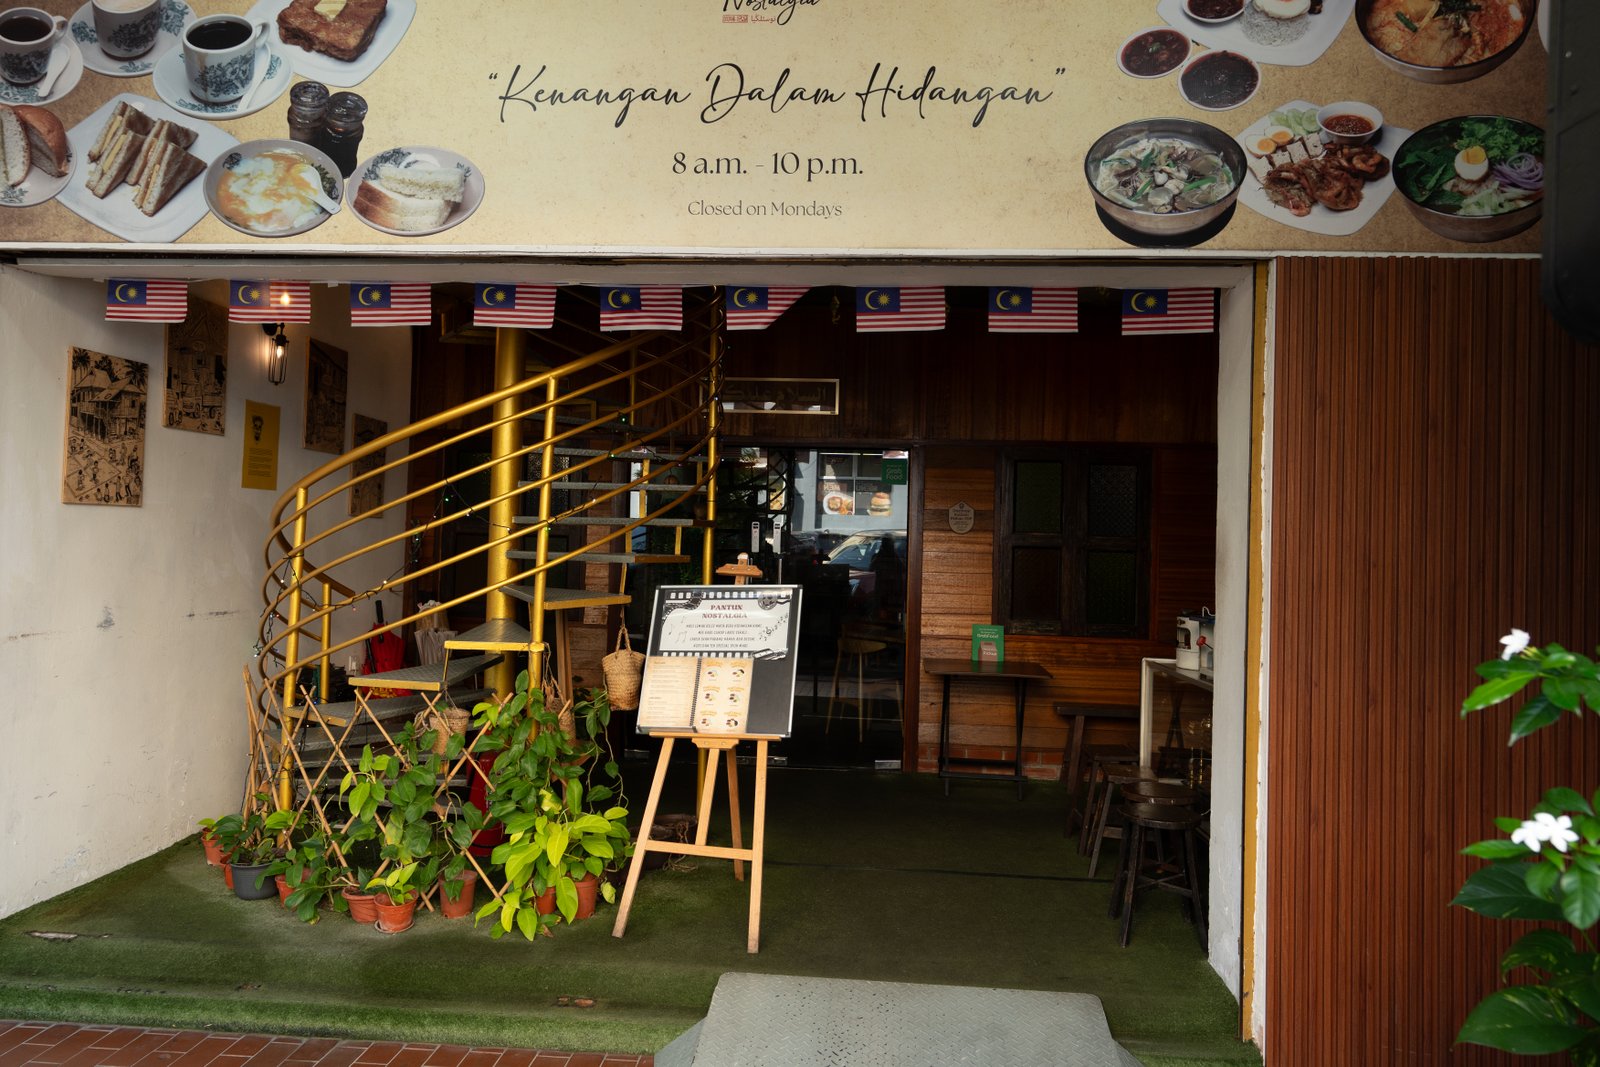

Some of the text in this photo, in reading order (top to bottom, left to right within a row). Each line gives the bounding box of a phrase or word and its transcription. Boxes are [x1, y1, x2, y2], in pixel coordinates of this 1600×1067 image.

[700, 62, 846, 124] Dalam
[672, 152, 687, 174] 8
[693, 157, 747, 174] a.m.
[772, 152, 800, 174] 10
[807, 157, 864, 182] p.m.
[687, 200, 843, 219] Closed on Mondays
